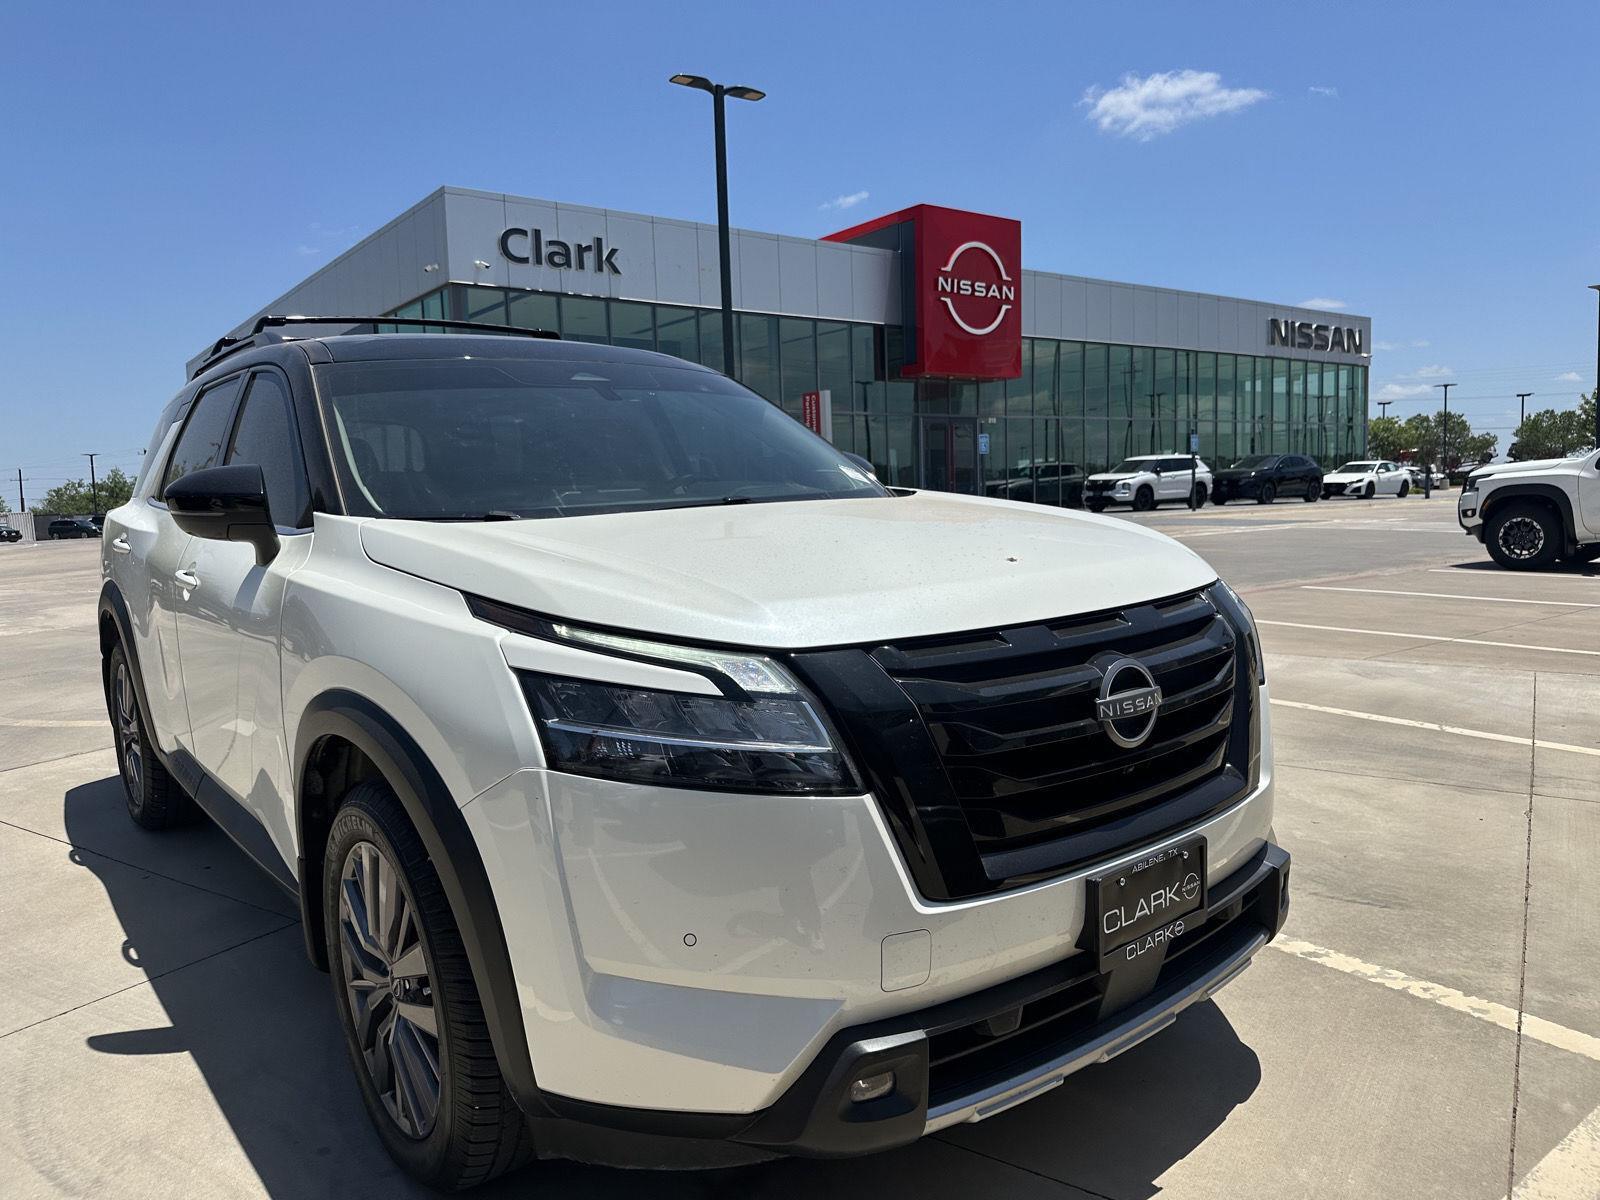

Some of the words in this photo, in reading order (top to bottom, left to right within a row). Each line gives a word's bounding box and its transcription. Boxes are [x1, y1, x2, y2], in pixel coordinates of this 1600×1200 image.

[499, 227, 622, 276] Clark
[938, 276, 1015, 301] NISSAN
[1267, 318, 1363, 354] NISSAN
[1100, 692, 1162, 718] NISSAN
[333, 814, 374, 845] MICHELIN
[1131, 853, 1166, 874] ABILENE,
[1168, 847, 1178, 857] TX
[1103, 881, 1181, 934] CLARK
[1126, 924, 1175, 960] CLARK
